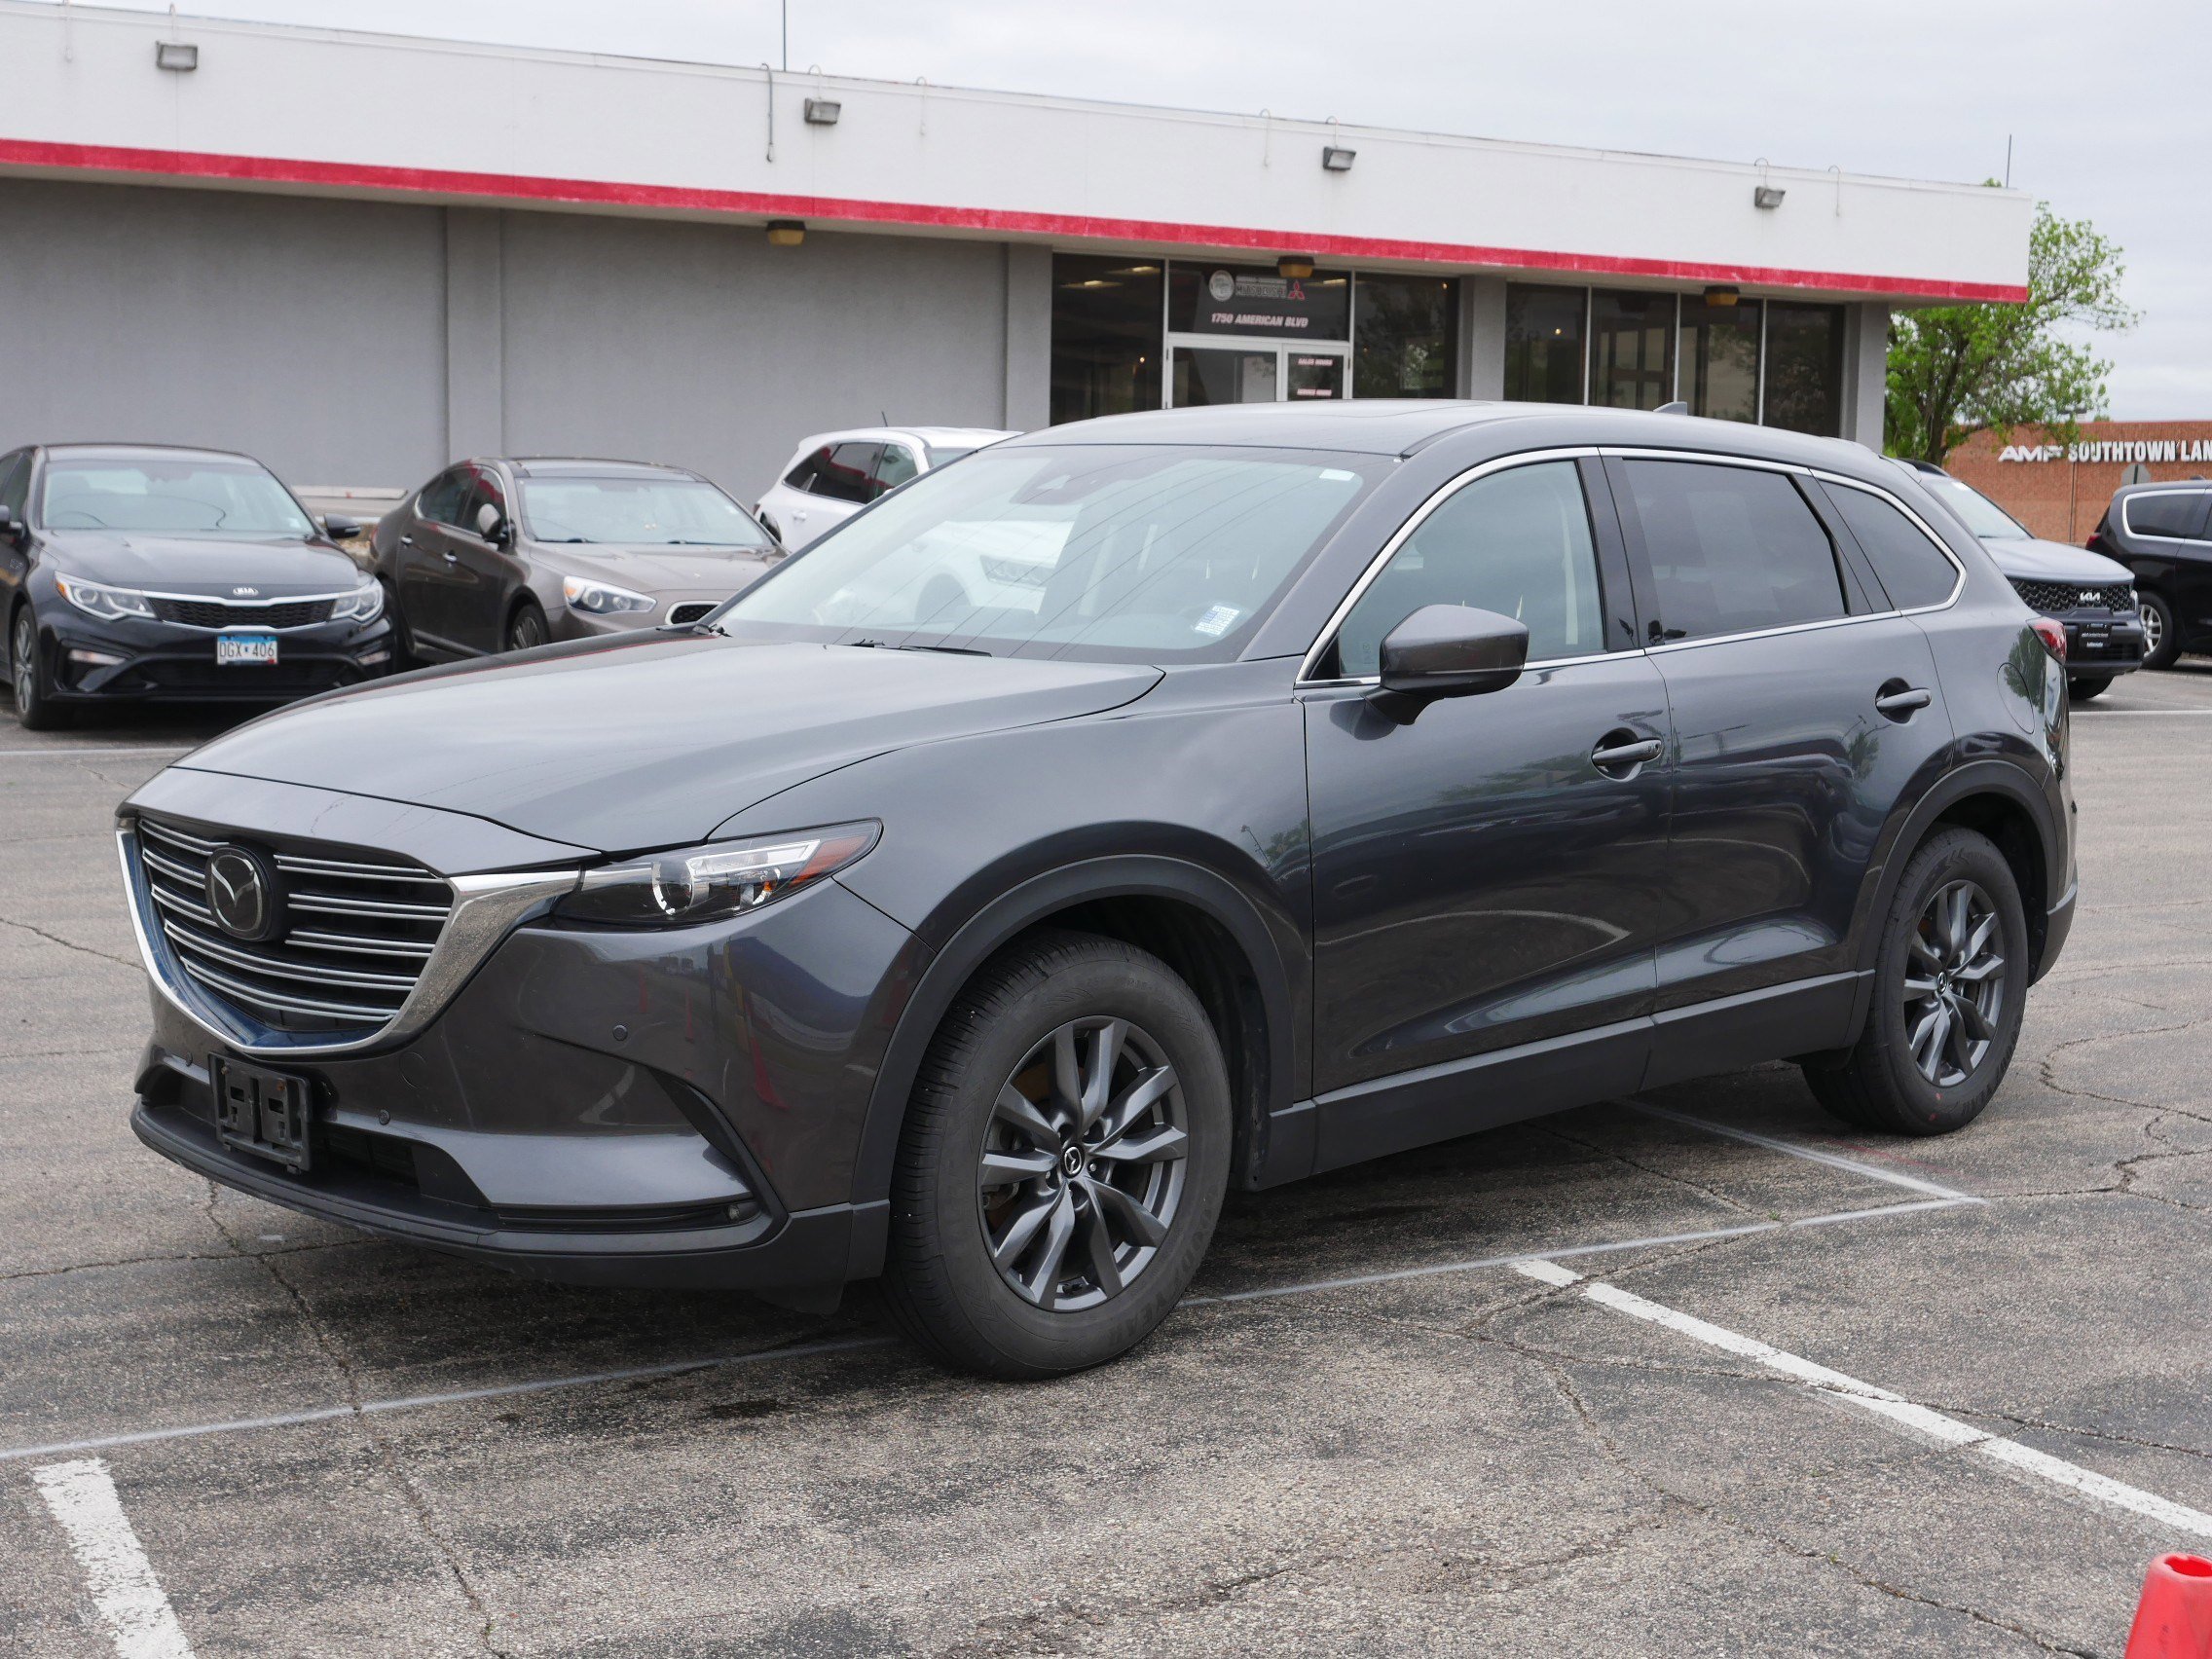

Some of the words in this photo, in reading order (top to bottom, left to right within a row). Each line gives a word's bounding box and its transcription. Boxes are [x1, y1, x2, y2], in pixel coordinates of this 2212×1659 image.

[1211, 313, 1234, 324] 1750
[1235, 313, 1284, 326] AMERICAN
[1284, 316, 1309, 328] BLVD
[1998, 445, 2064, 462] AMF
[2068, 440, 2176, 462] SOUTHTOWN
[2181, 439, 2212, 462] LAN
[219, 643, 242, 657] DGX
[252, 643, 275, 657] 406
